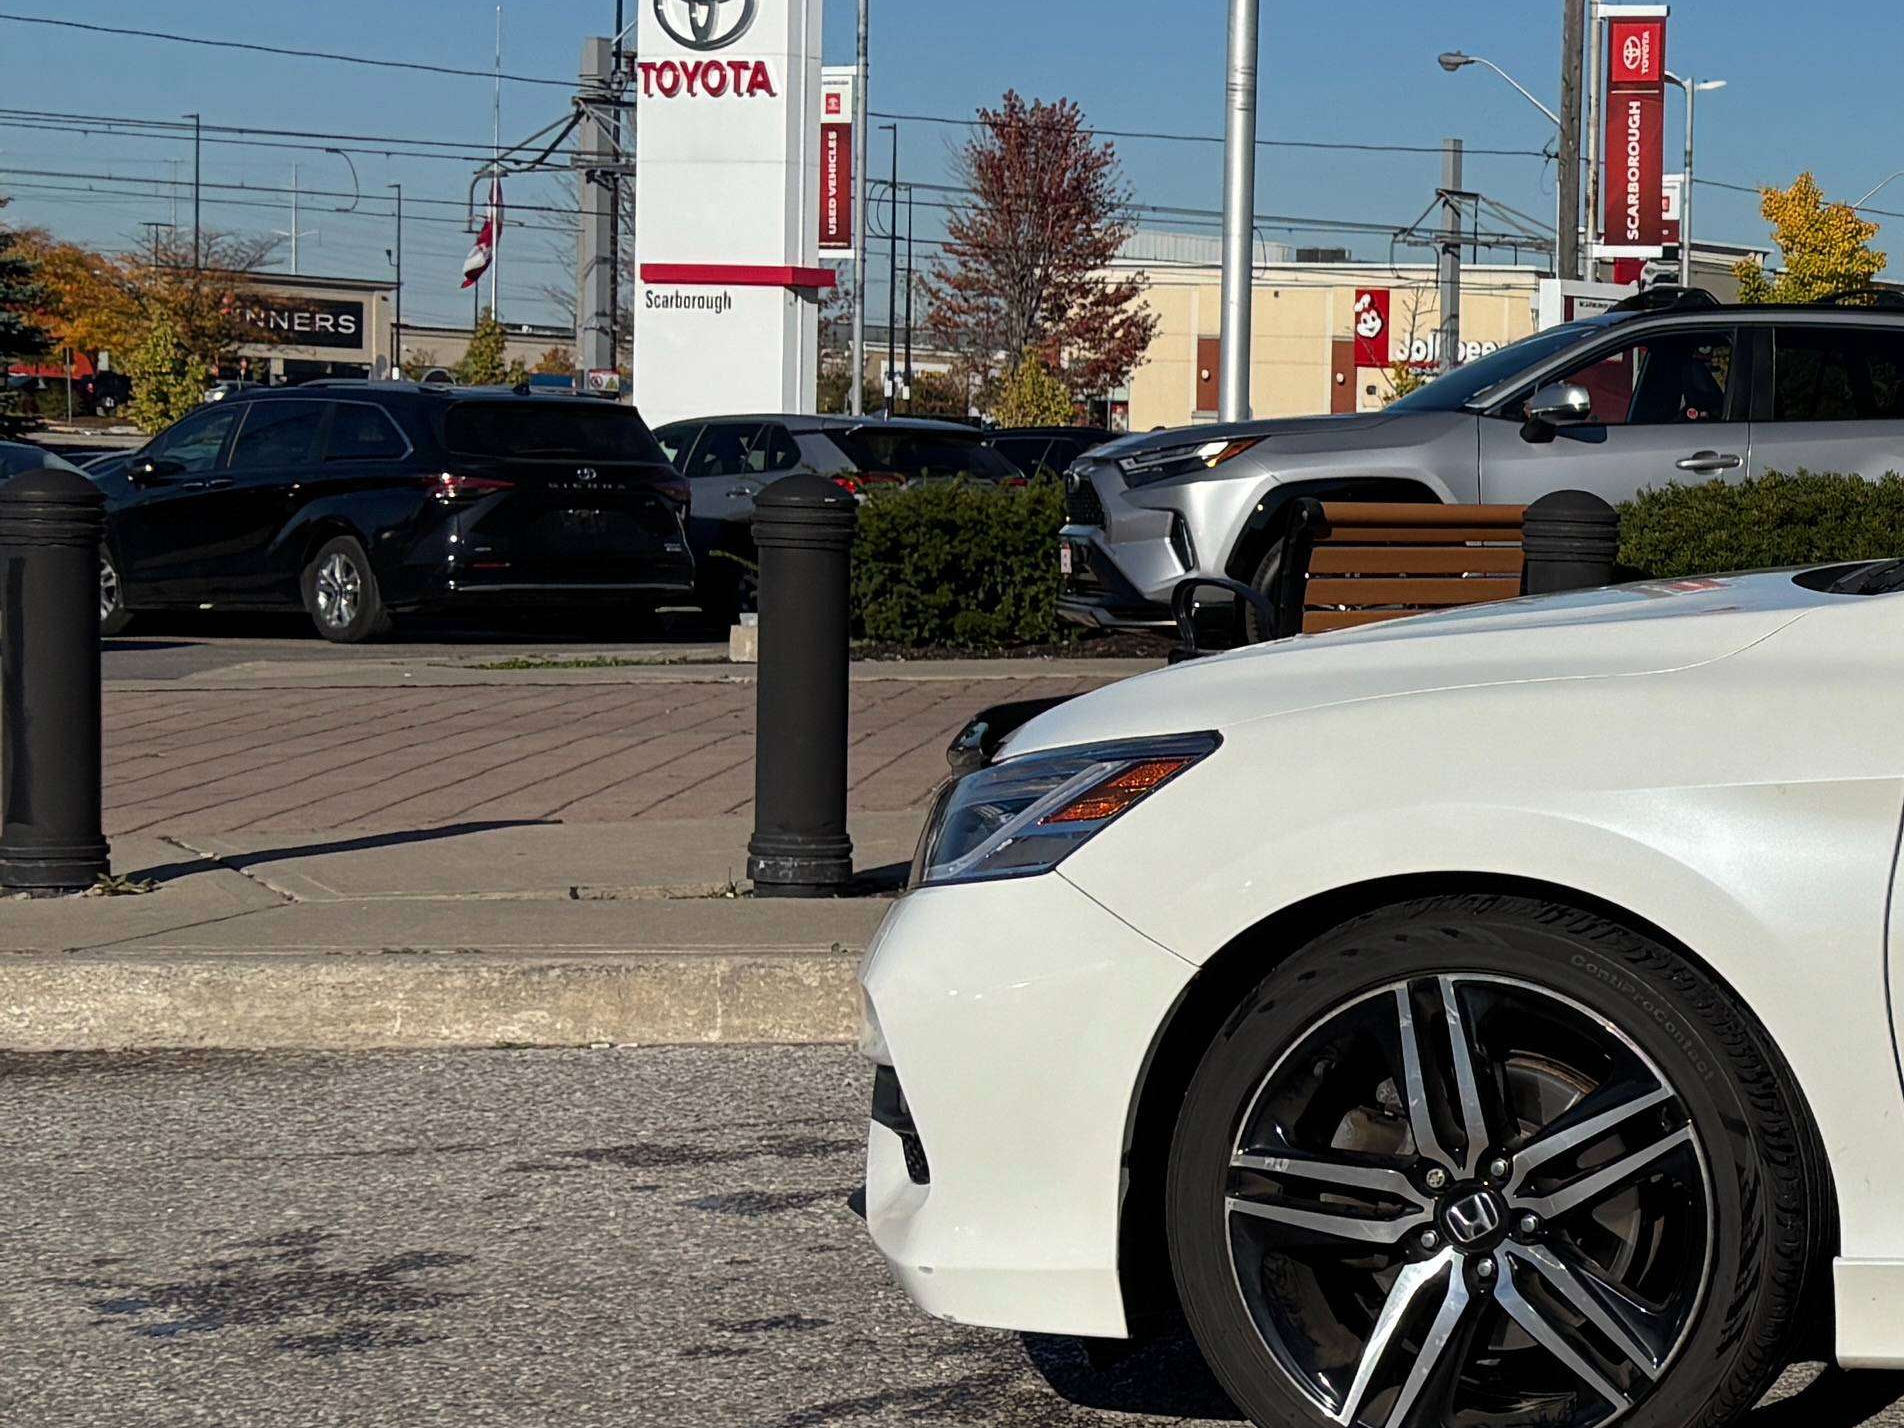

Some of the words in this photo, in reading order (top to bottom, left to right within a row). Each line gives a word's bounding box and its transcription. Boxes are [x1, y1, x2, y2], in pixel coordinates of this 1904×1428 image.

[1641, 30, 1650, 75] TOYOTA
[637, 59, 777, 98] TOYOTA
[828, 131, 837, 197] VEHICLES
[1627, 101, 1641, 240] SCARBOROUGH
[828, 198, 837, 235] USED
[645, 289, 732, 314] Scarborough
[1570, 953, 1715, 1082] ContiProContact
